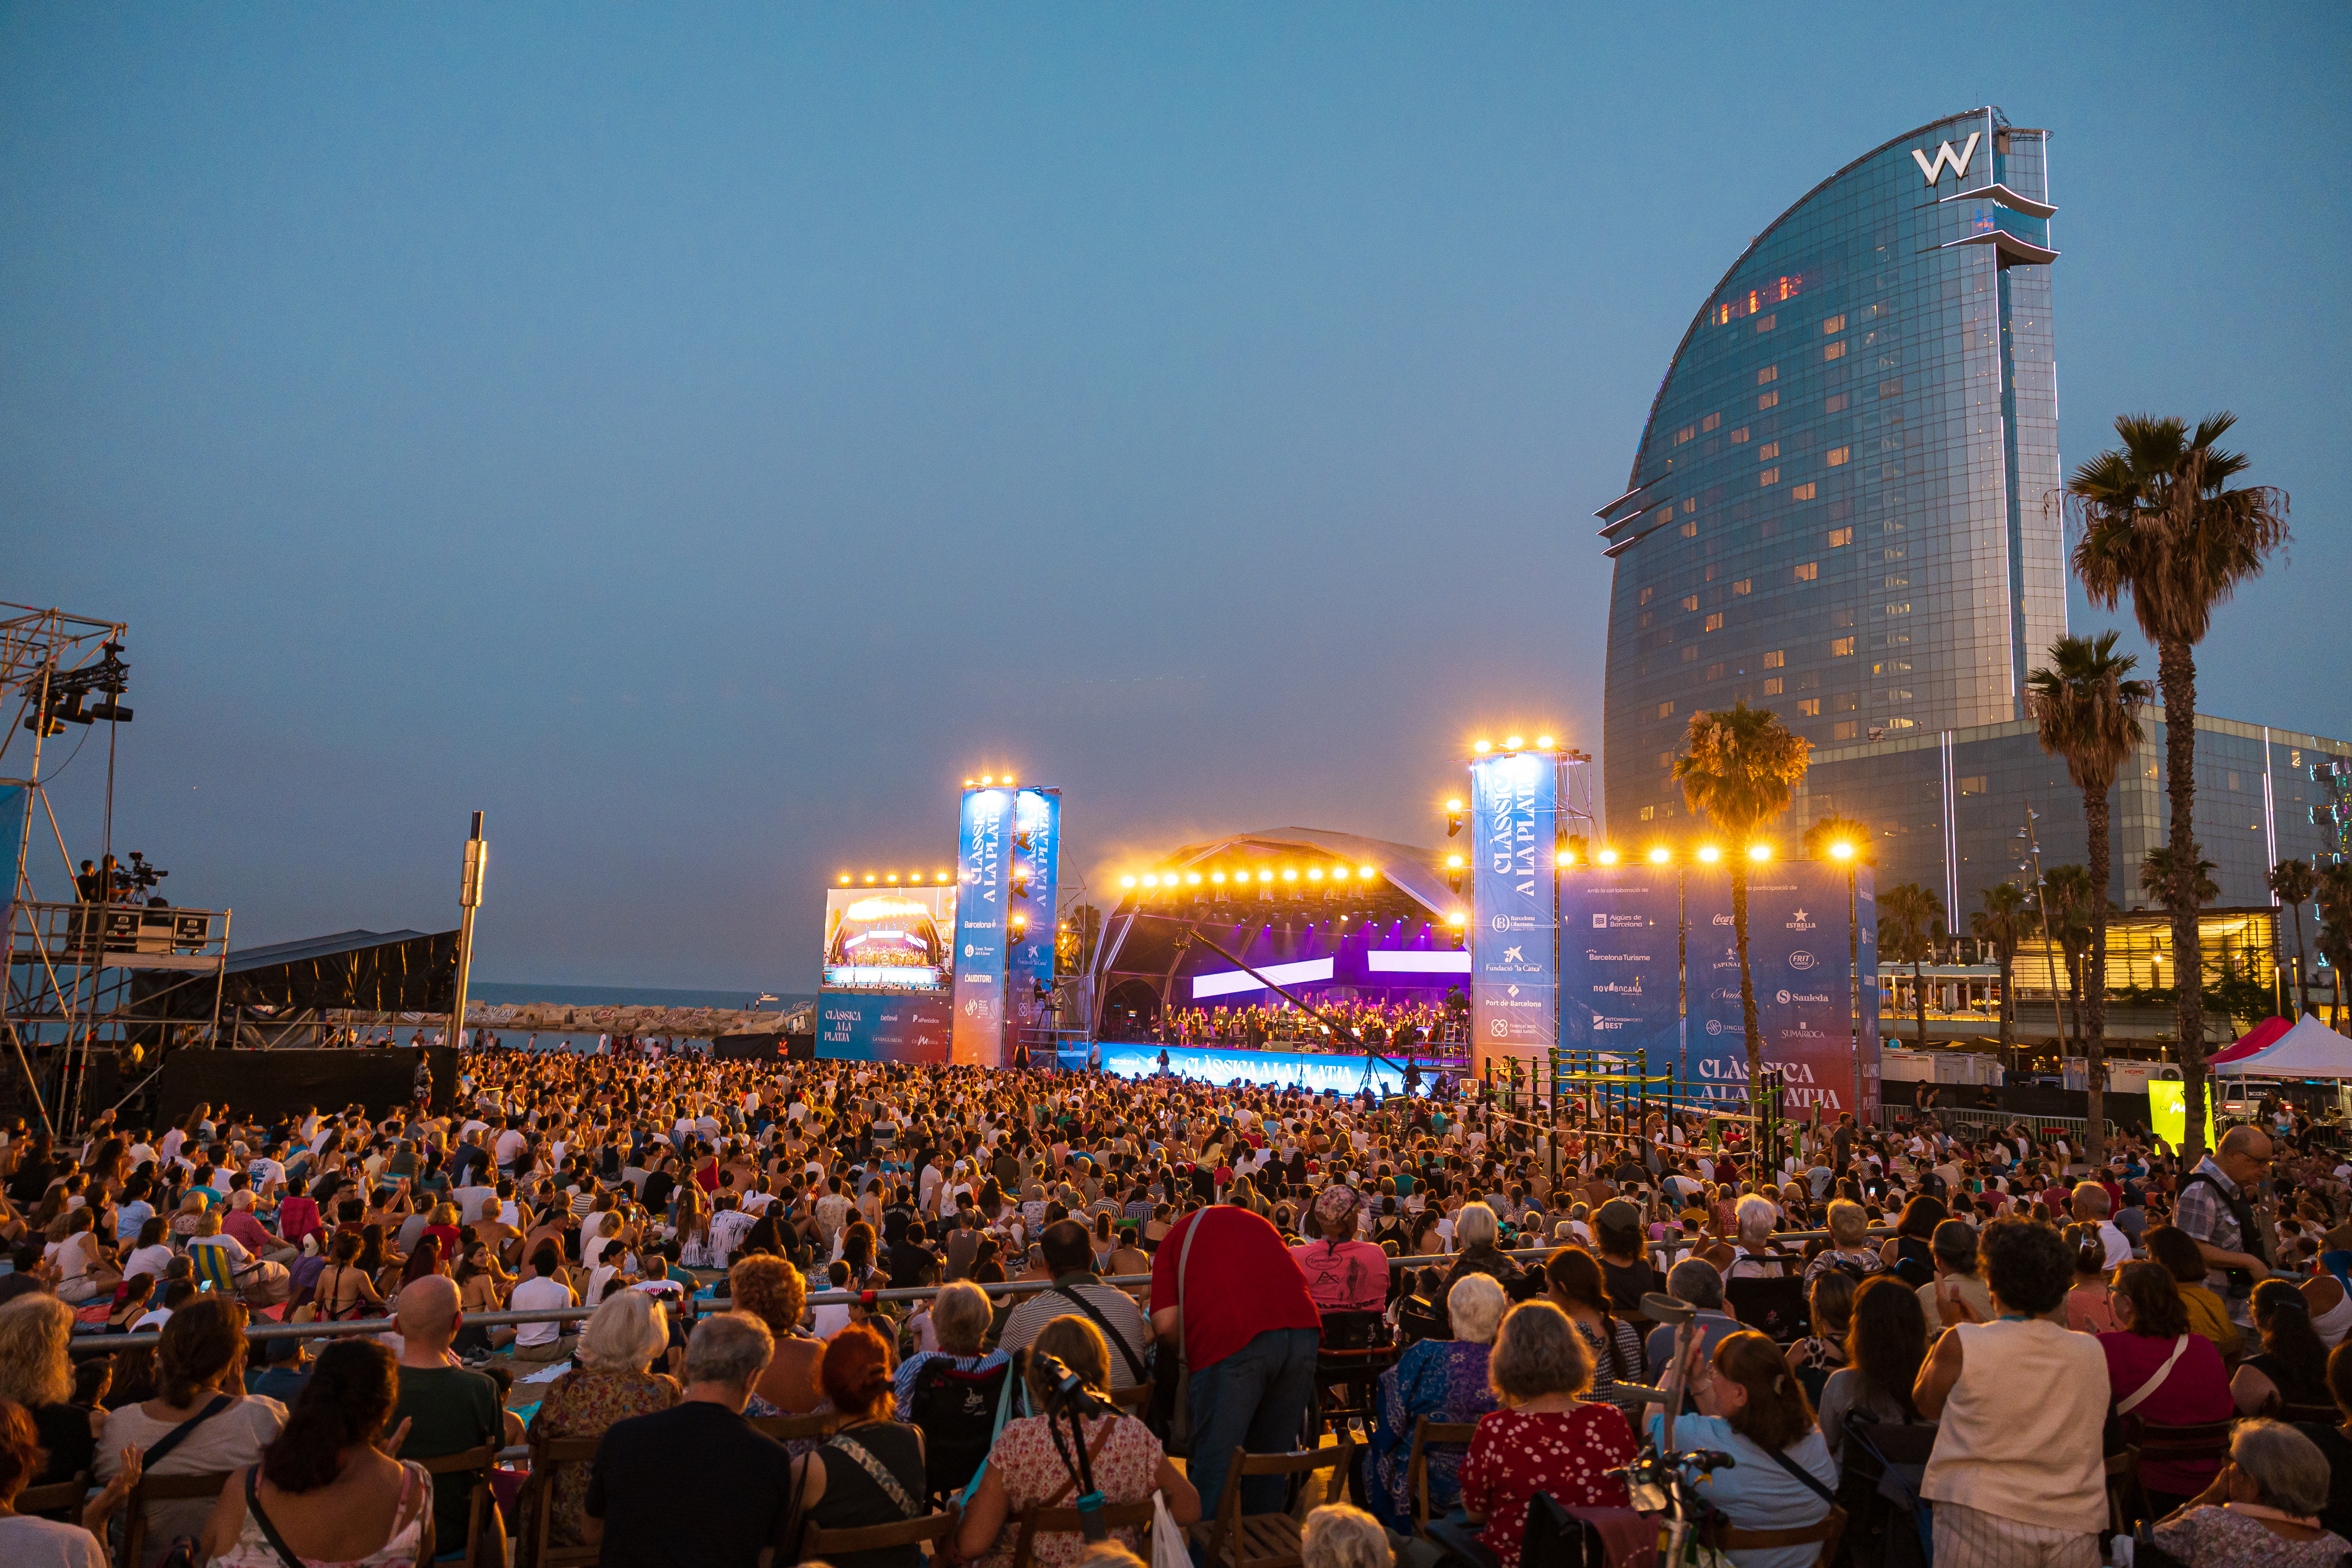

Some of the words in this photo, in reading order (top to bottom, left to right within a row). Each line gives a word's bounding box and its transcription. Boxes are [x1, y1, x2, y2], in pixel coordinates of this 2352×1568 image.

[1912, 131, 1981, 186] W
[1038, 802, 1050, 864] PLATJA
[1024, 802, 1038, 887] CLÀSSIC
[1516, 845, 1535, 876] LA
[984, 862, 997, 886] LA
[1037, 868, 1047, 891] LA
[1516, 880, 1534, 897] A
[983, 890, 995, 902] A
[1037, 895, 1046, 907] A
[1712, 913, 1749, 926] Coca-C
[1713, 961, 1751, 969] ESPINALR
[964, 972, 992, 983] L'AUDITORI
[1711, 987, 1742, 1000] Nada
[1792, 994, 1829, 1002] Sauleda
[825, 1008, 861, 1021] CLÀSSICA
[836, 1021, 841, 1031] A
[842, 1021, 852, 1031] LA
[824, 1031, 850, 1042] PLATJA
[1781, 1029, 1825, 1039] SUMARROCA
[1109, 1057, 1135, 1066] Barcelona
[1185, 1055, 1257, 1077] CLÀSSICA
[1259, 1061, 1271, 1078] A
[1273, 1062, 1294, 1079] LA
[1296, 1064, 1352, 1083] PLATJA
[1699, 1056, 1815, 1083] CLÀSSICA
[1700, 1085, 1714, 1102] A
[1720, 1086, 1750, 1104] LA
[1783, 1087, 1841, 1109] ATJA
